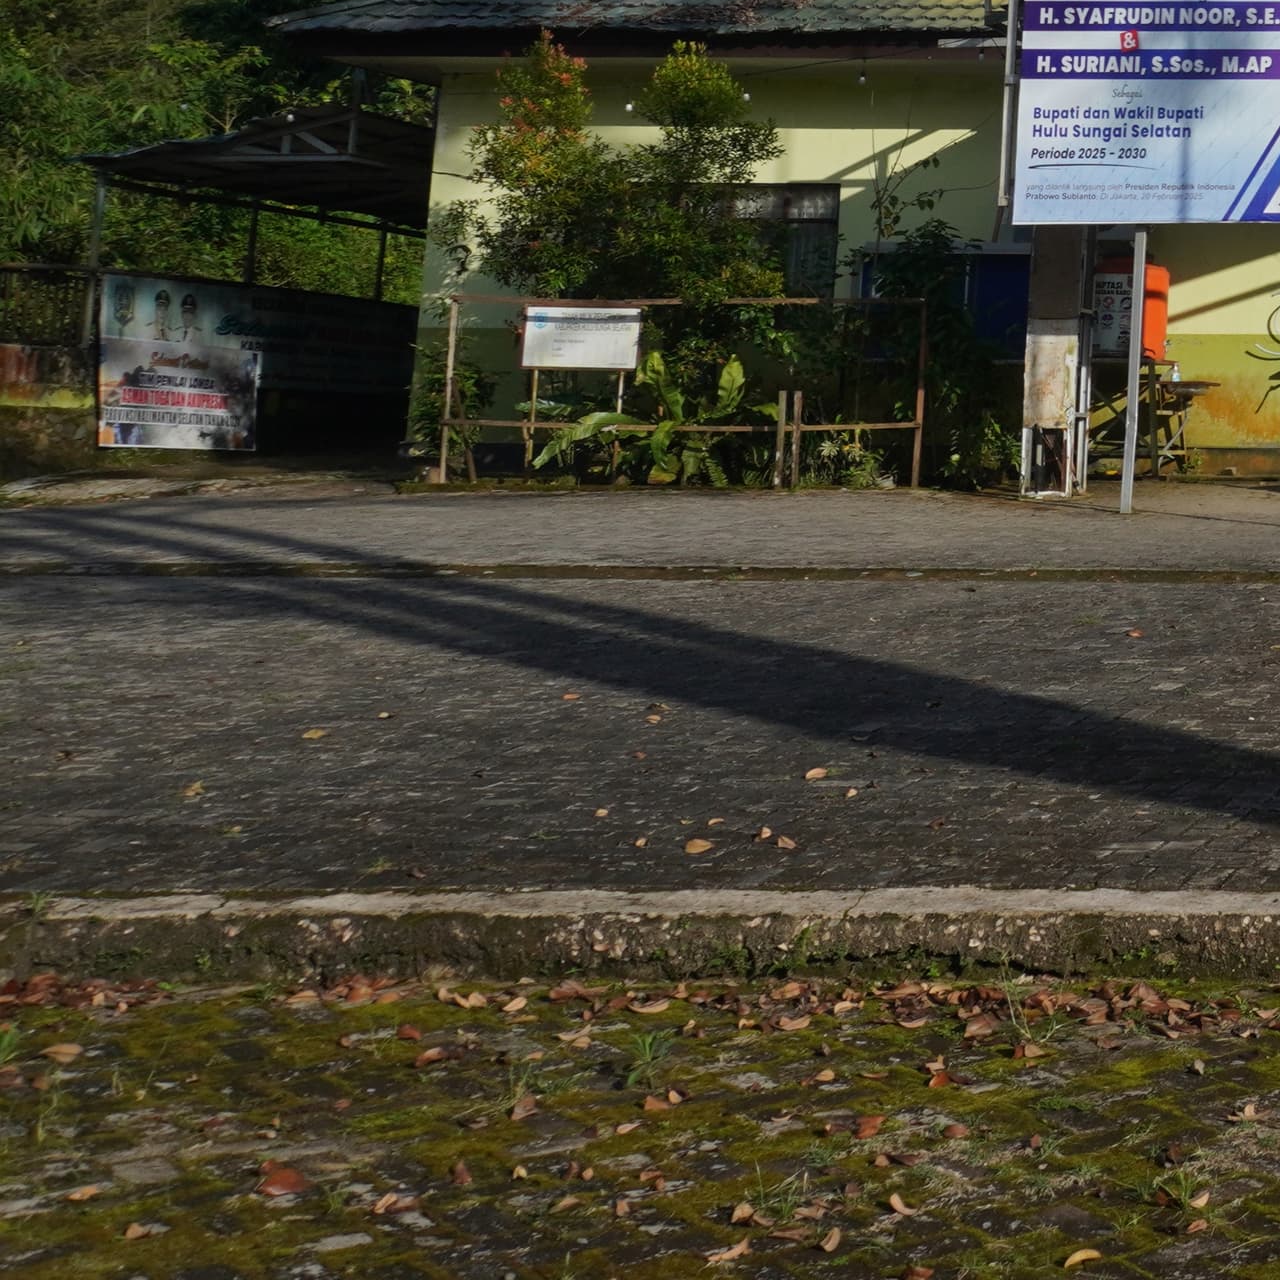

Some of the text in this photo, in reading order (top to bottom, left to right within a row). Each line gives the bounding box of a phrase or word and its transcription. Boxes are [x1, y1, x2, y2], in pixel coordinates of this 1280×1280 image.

[1039, 7, 1059, 25] H.
[1064, 7, 1175, 26] SYAFRUDIN
[1179, 7, 1240, 28] NOOR,
[1122, 31, 1137, 49] &
[1036, 55, 1273, 76] H. SURIANI, S.Sos., M.AP
[1111, 84, 1143, 104] Sebagai
[1033, 105, 1204, 123] Bupati dan Wakil Bupati
[1032, 123, 1192, 143] Hulu Sungai Selatan
[1030, 147, 1076, 160] Periode
[1078, 148, 1107, 160] 2025
[1118, 148, 1147, 160] 2030
[1025, 192, 1060, 201] Prabowo
[1026, 184, 1044, 193] yang
[1124, 183, 1159, 192] Presiden
[1161, 183, 1195, 193] Republik
[1197, 183, 1235, 192] Indonesia
